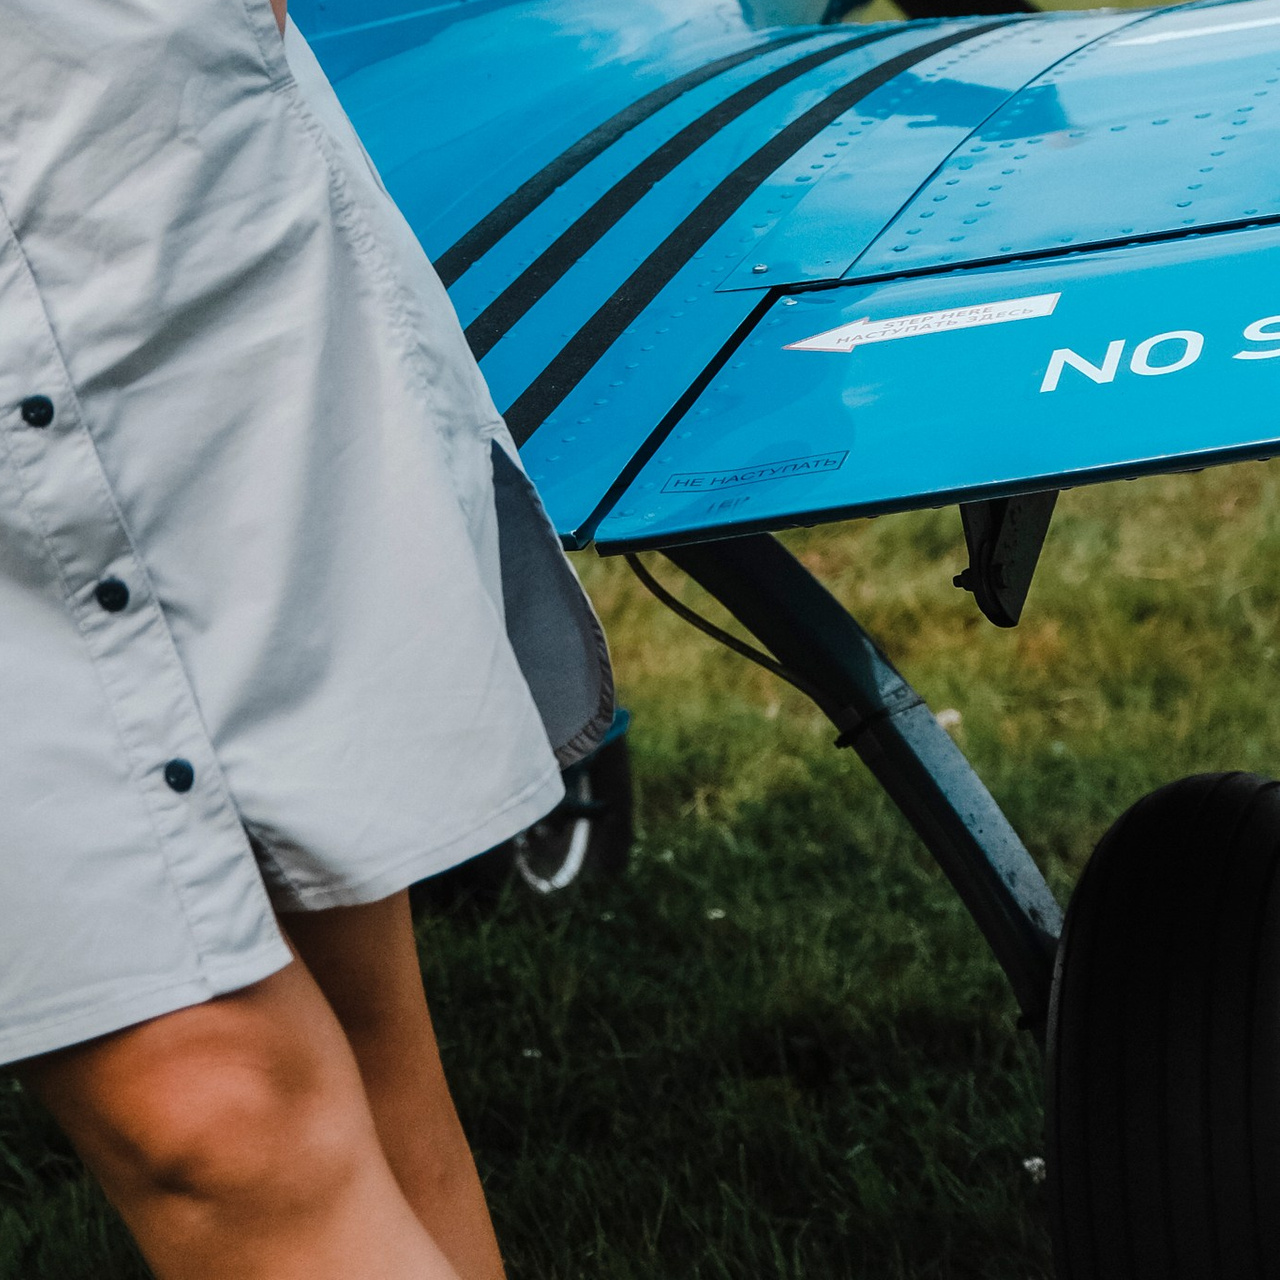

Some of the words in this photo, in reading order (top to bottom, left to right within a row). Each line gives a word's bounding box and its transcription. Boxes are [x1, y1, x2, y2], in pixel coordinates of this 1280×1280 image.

[835, 319, 959, 345] НАСТУПАТЬ
[968, 307, 1035, 323] ЗДЕСЬ
[882, 315, 934, 329] STEP
[941, 305, 994, 320] HERE
[1039, 329, 1205, 393] NO
[673, 477, 706, 488] НЕ
[709, 458, 838, 486] НАСТУПАТЬ
